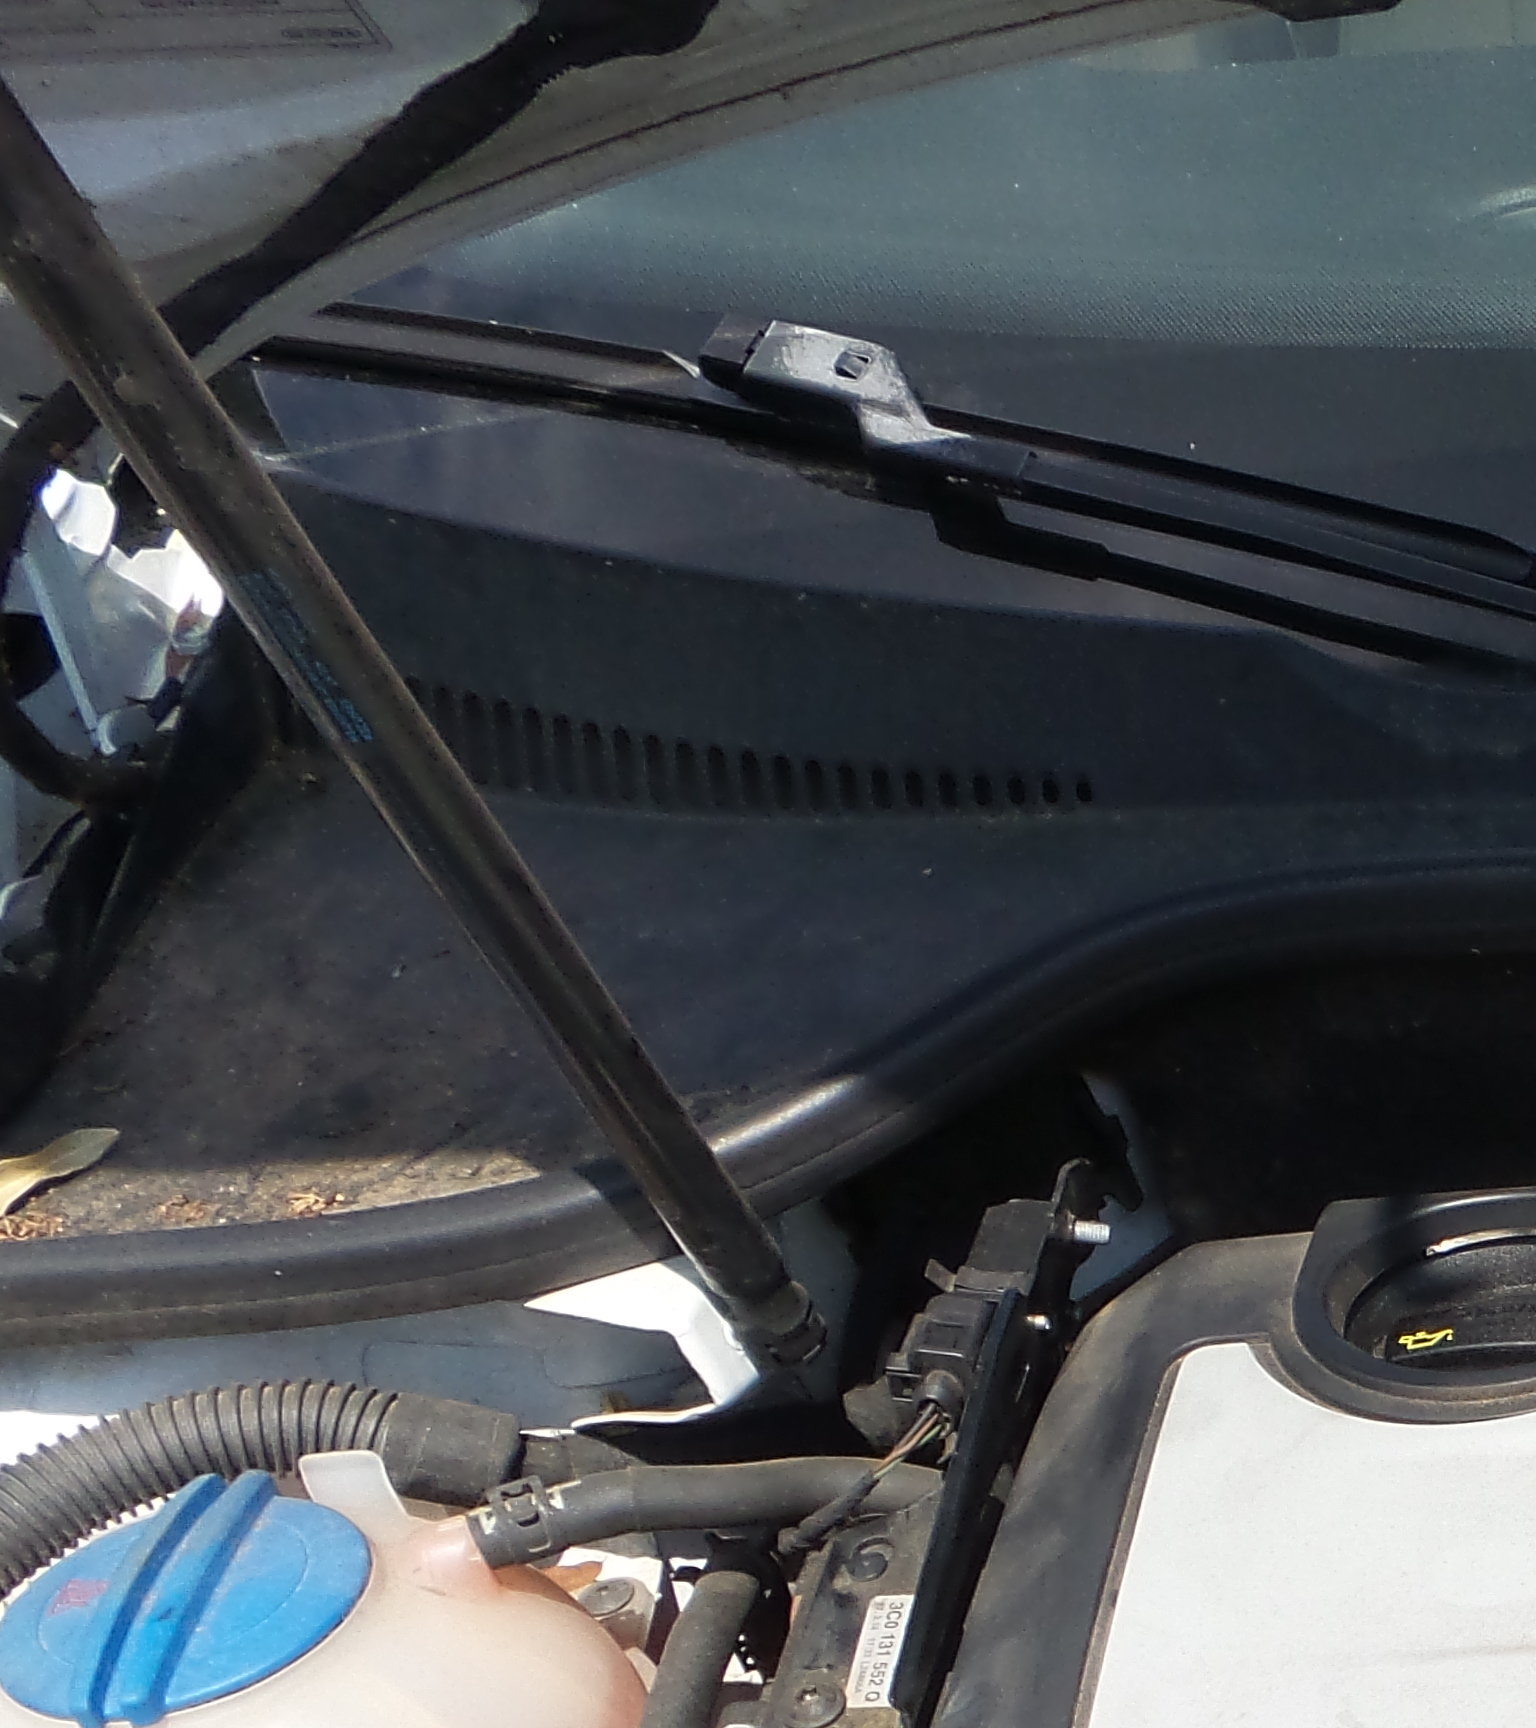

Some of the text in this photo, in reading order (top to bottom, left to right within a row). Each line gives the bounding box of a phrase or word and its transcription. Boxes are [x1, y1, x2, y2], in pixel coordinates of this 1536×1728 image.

[884, 1601, 904, 1629] 3C0
[877, 1634, 896, 1657] 131
[868, 1662, 889, 1687] 552
